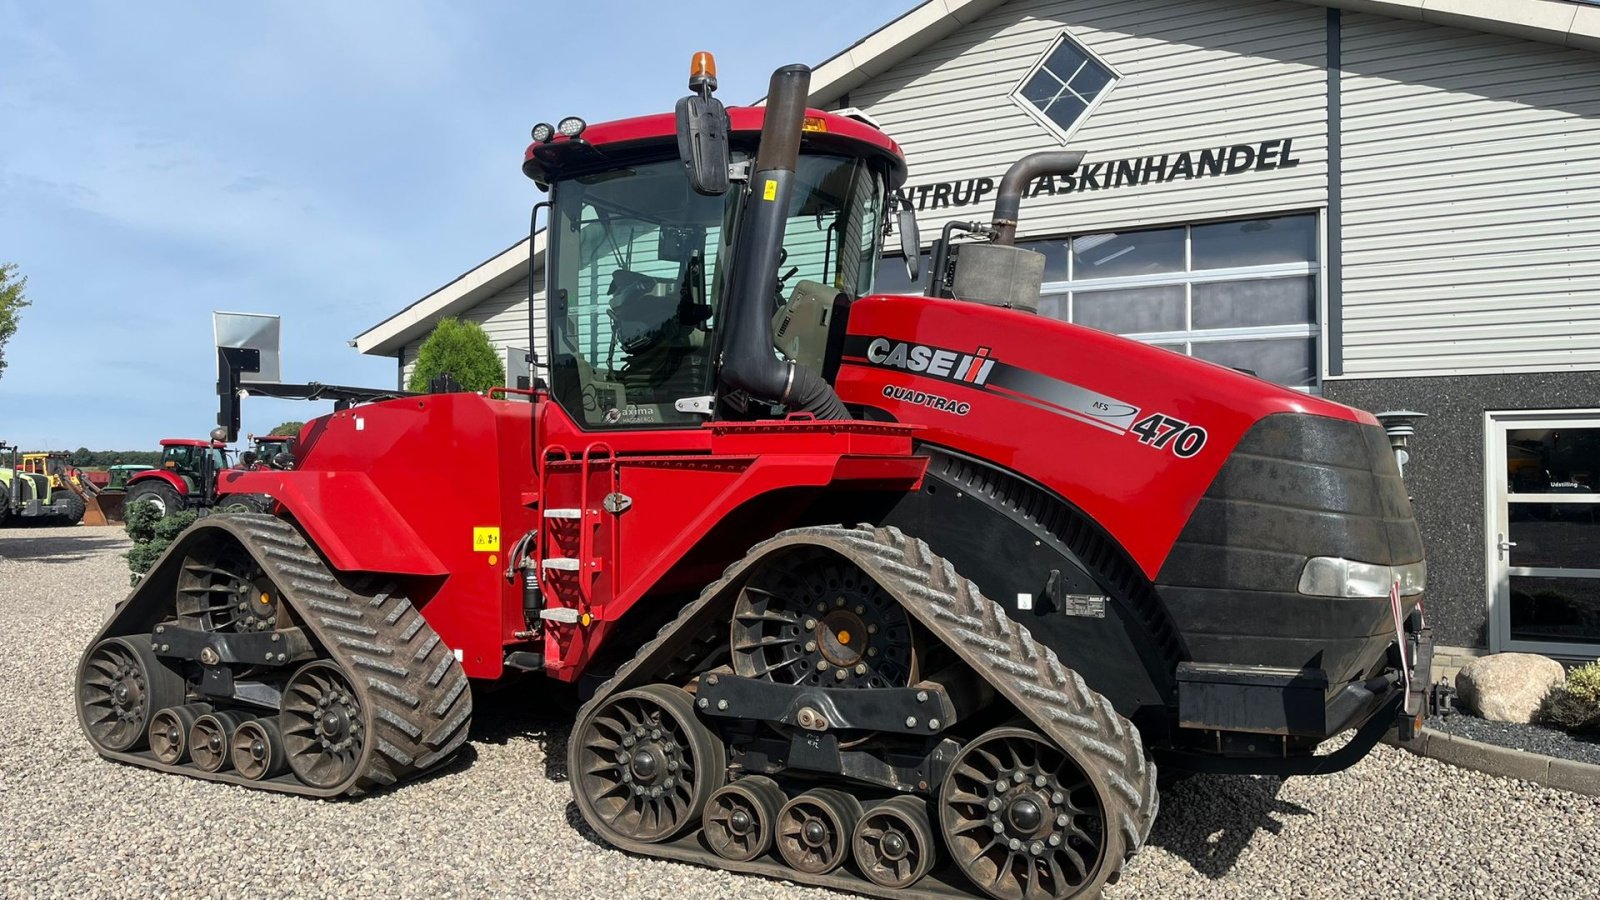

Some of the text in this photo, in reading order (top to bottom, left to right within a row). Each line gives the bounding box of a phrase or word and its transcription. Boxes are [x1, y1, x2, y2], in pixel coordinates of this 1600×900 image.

[1021, 138, 1300, 198] ASKINHANDEL
[882, 384, 971, 416] QUADTRAC
[1092, 401, 1109, 411] AFS
[1130, 412, 1208, 458] 470
